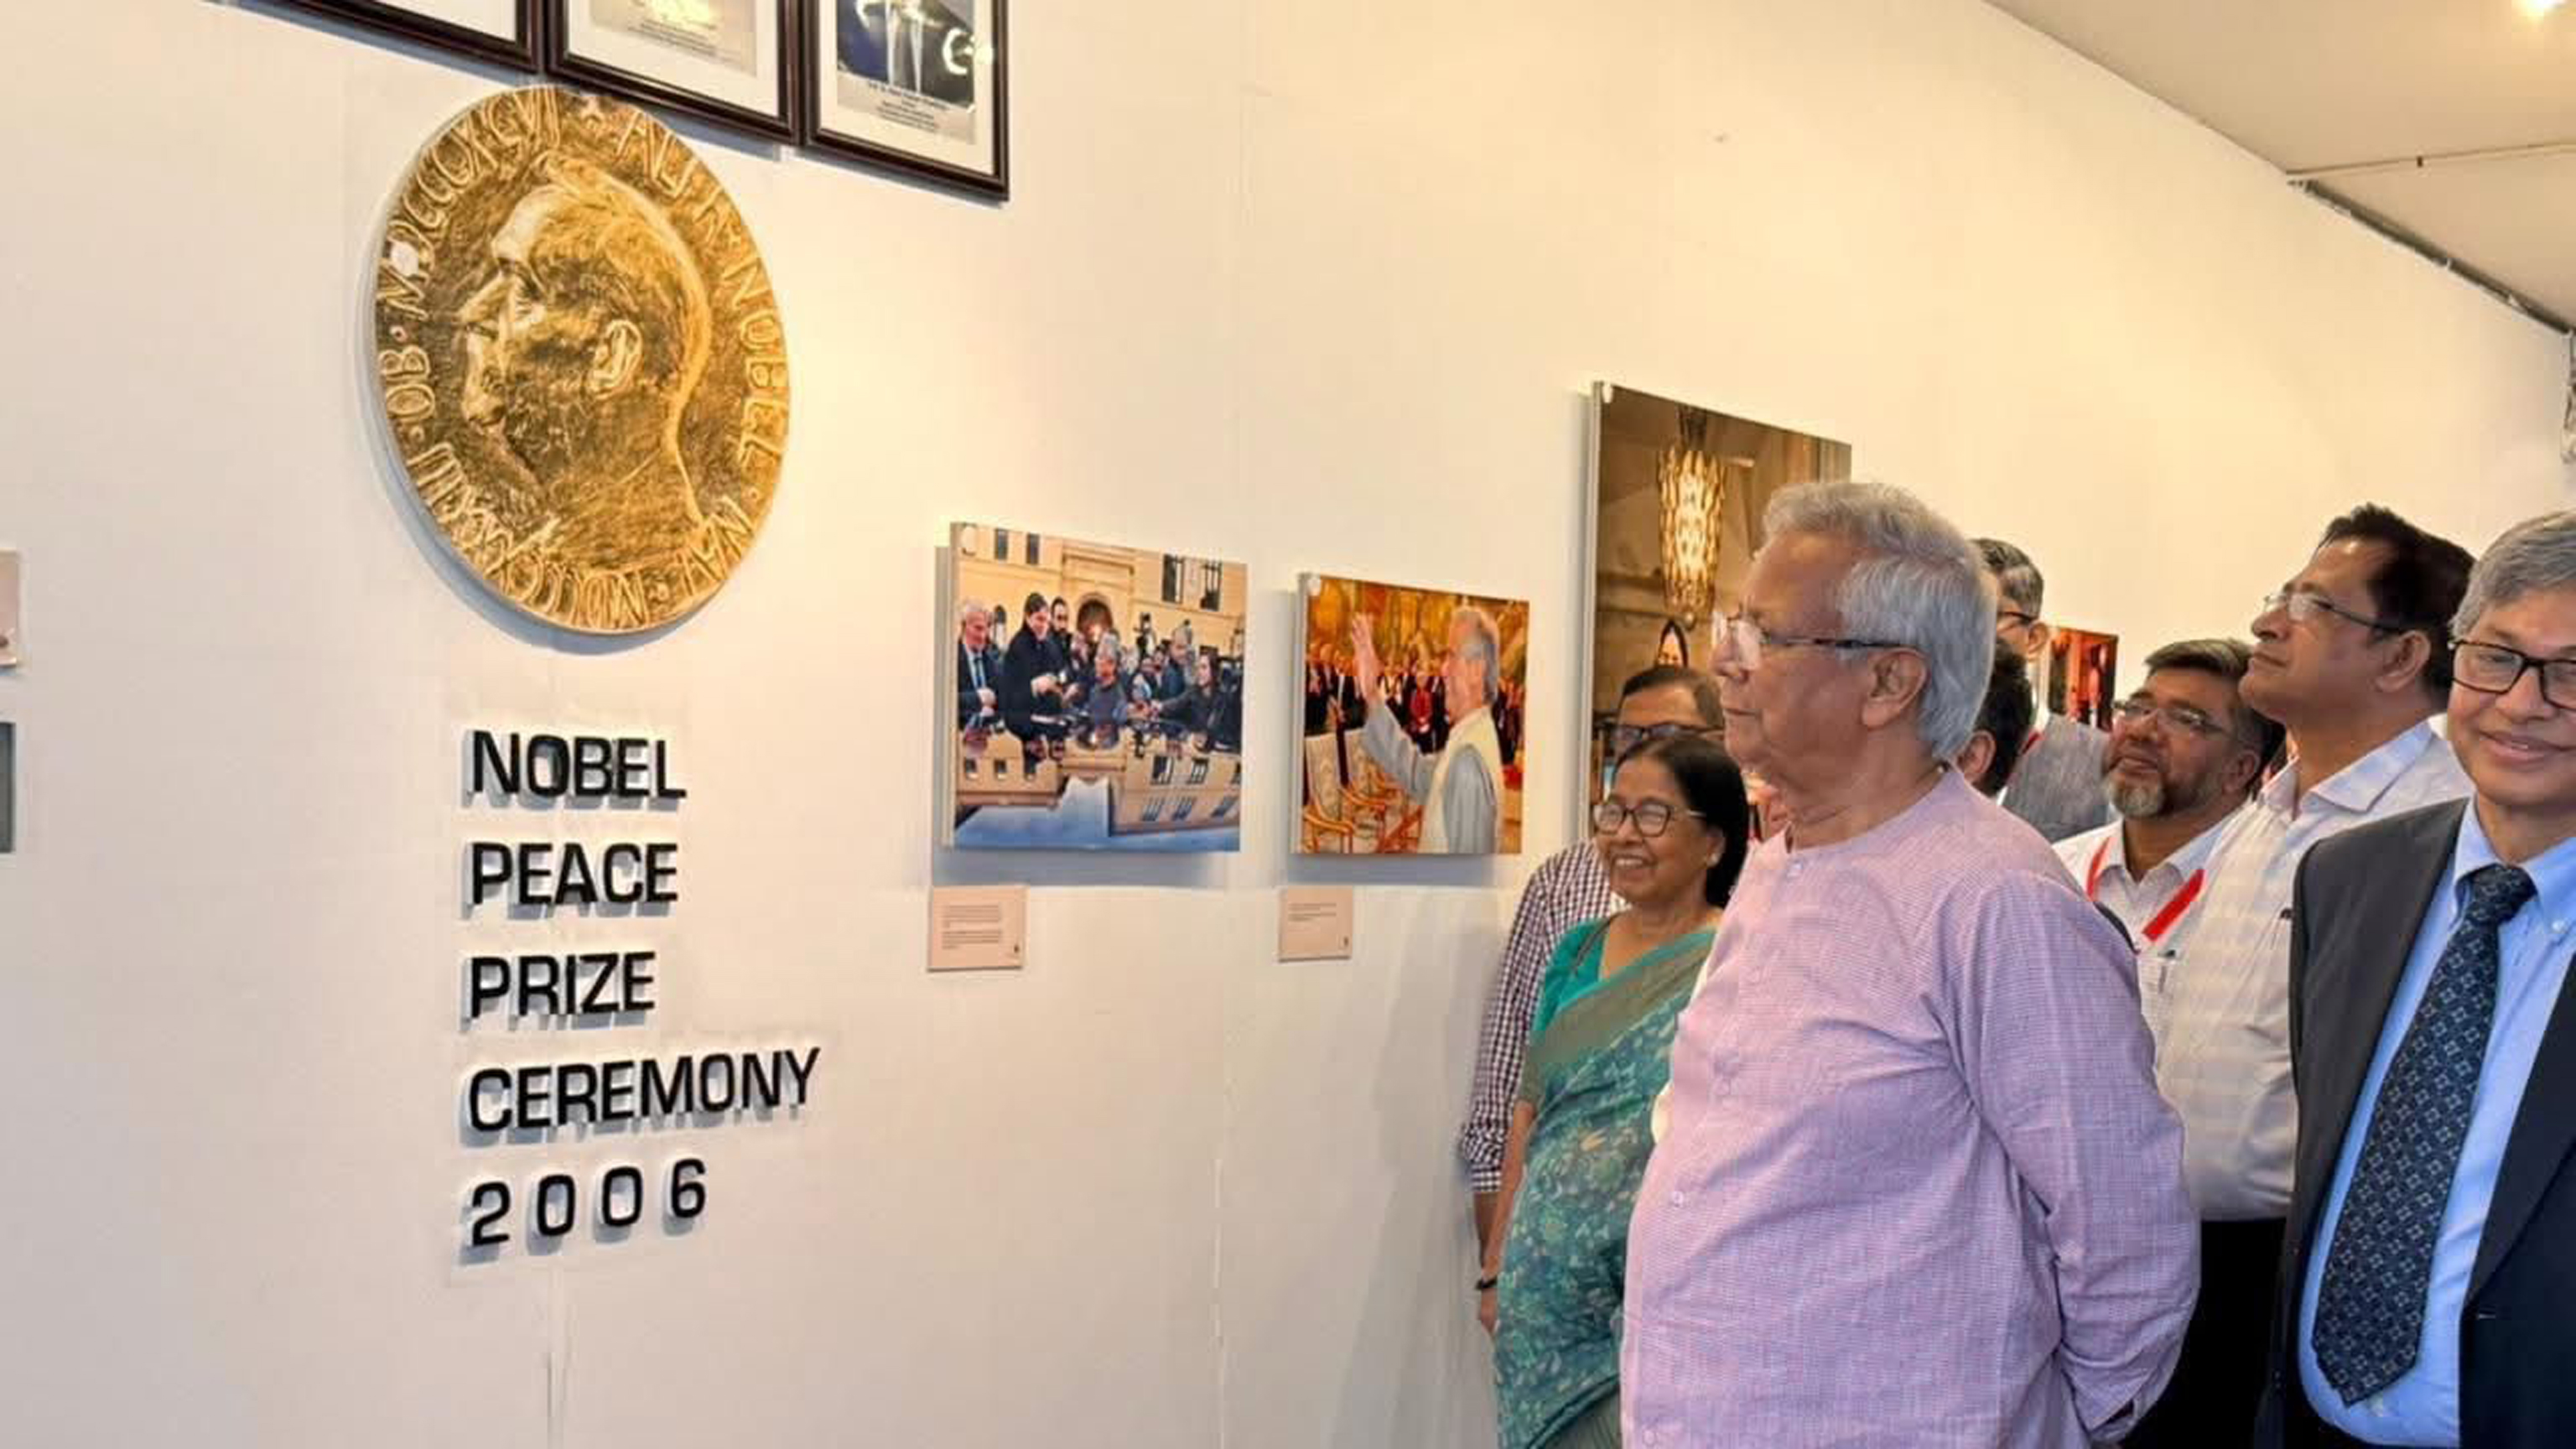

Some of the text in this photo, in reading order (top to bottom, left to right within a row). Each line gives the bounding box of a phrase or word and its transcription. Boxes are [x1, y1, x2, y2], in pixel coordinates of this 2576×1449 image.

[473, 730, 687, 798] NOBEL
[472, 842, 678, 905] PEACE
[470, 951, 656, 1019] PRIZE
[470, 1047, 821, 1132] CEREMONY
[470, 1158, 707, 1248] 2006
